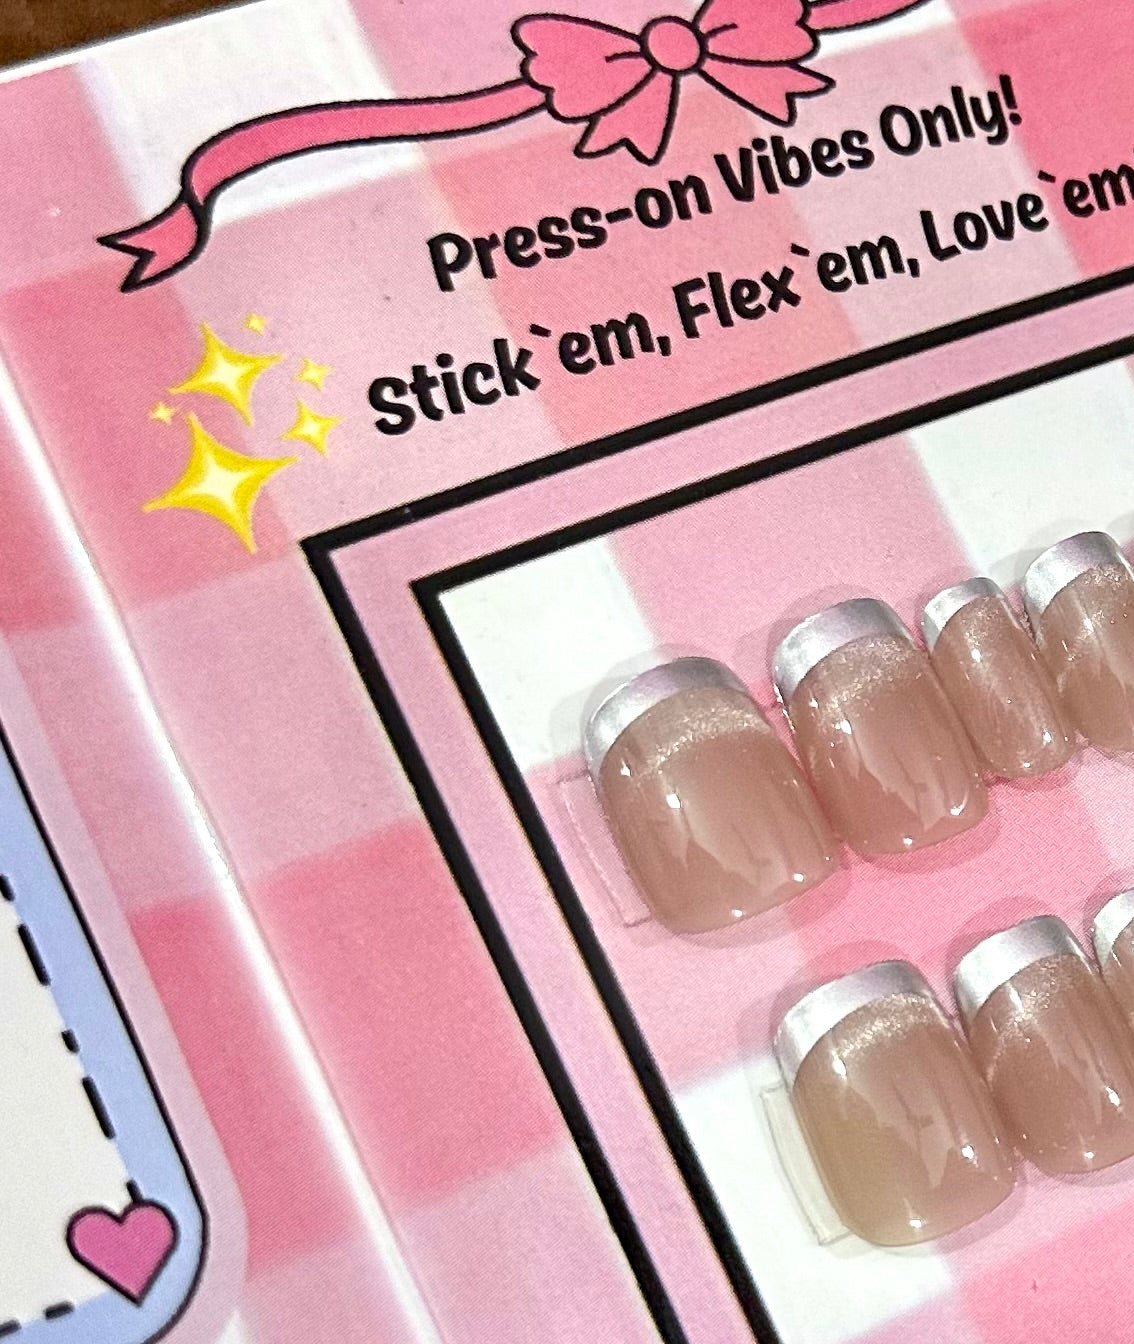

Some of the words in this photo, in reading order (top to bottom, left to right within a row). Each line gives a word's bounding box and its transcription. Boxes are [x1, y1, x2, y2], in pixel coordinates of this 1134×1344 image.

[427, 174, 712, 293] Press-on
[714, 130, 875, 203] Vibes
[880, 74, 1023, 156] Only!
